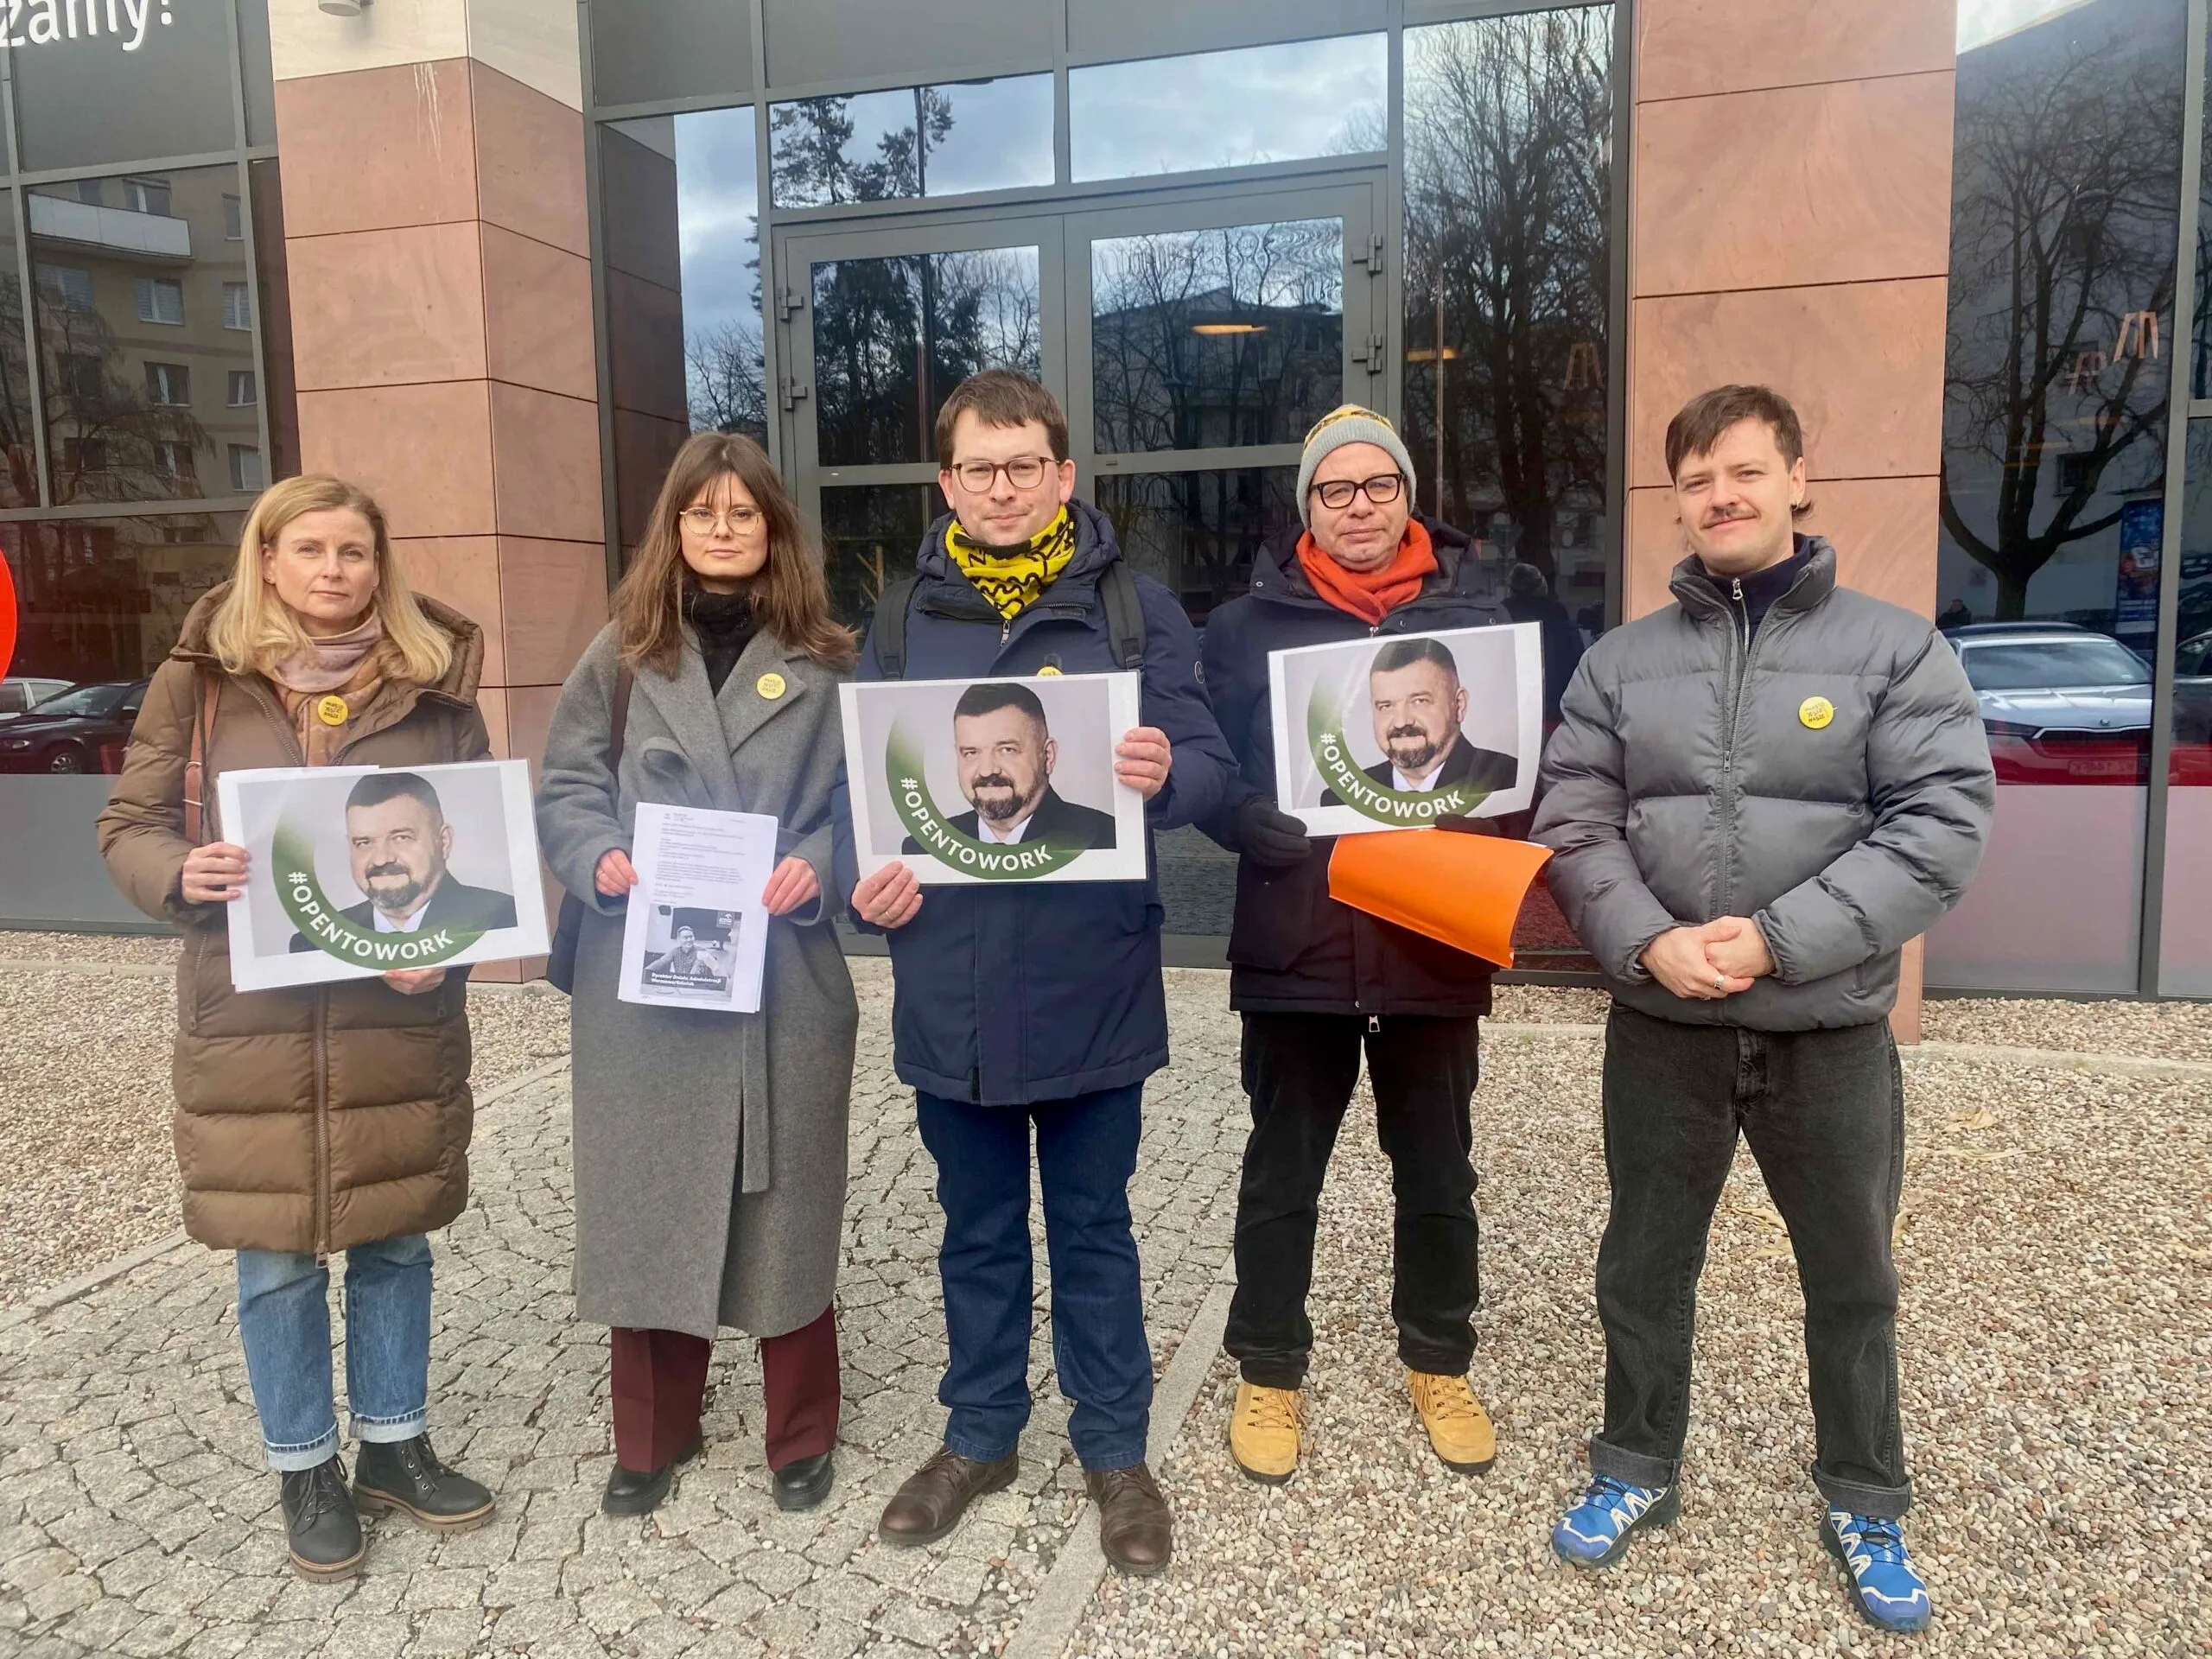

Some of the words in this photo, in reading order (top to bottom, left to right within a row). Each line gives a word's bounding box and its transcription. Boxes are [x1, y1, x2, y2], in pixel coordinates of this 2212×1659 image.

[1319, 733, 1465, 818] #OPENTOWORK
[900, 777, 1053, 871] #OPENTOWORK
[288, 871, 454, 961] #OPENTOWORK
